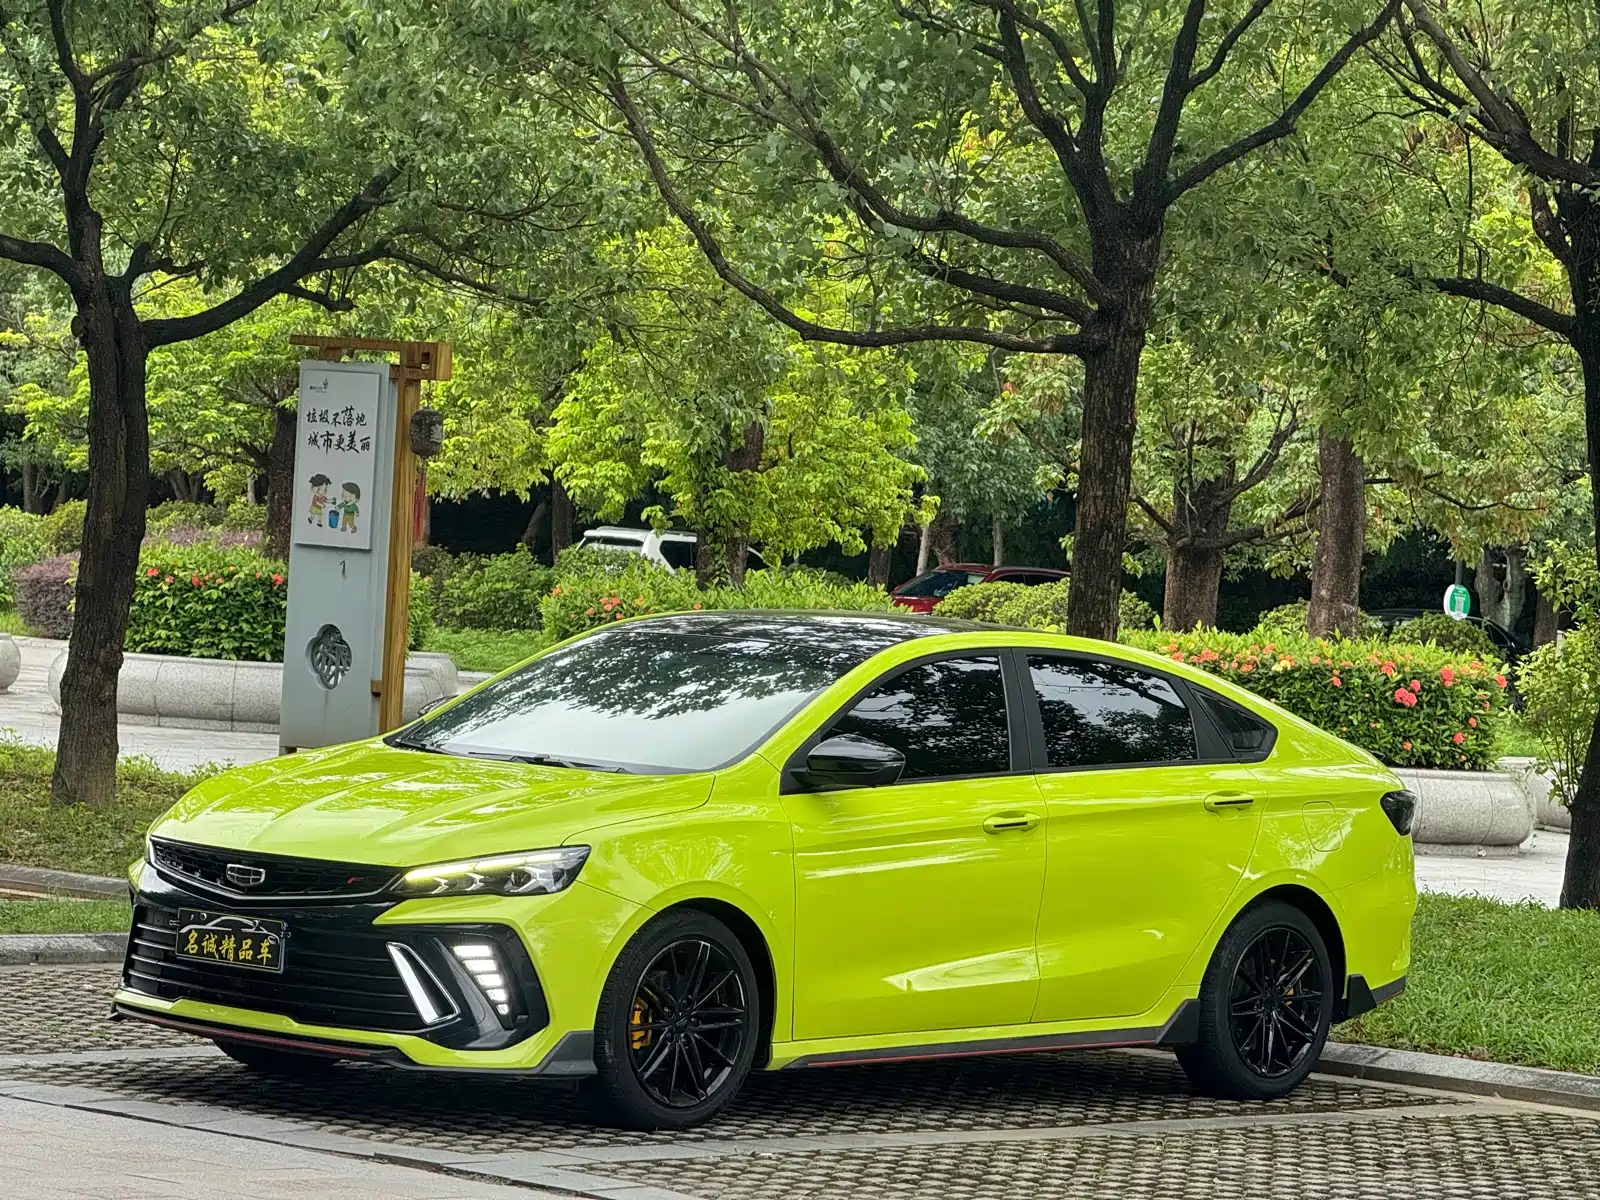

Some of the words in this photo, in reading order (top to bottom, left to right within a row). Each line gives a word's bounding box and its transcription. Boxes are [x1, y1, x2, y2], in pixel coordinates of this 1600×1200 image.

[306, 405, 367, 427] 垃圾不落地
[308, 430, 371, 454] 城市更美丽
[184, 929, 272, 966] 名诚精品车
